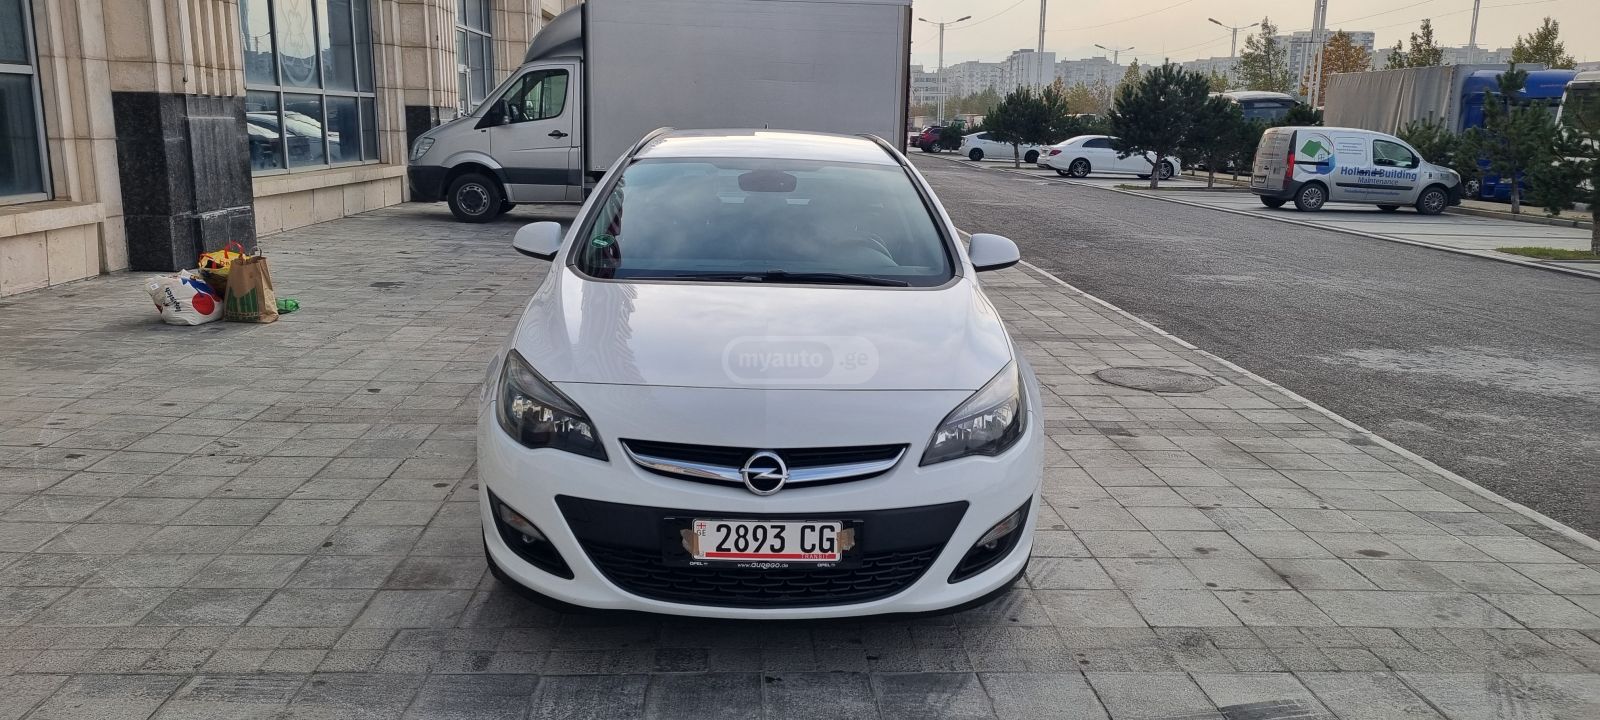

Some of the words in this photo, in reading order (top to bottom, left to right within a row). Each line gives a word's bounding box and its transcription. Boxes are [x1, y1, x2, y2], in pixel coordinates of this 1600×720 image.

[1341, 166, 1377, 177] Holland
[1379, 168, 1417, 182] Building
[1358, 177, 1399, 185] Maintenance
[715, 524, 786, 553] 2893
[800, 524, 836, 553] CG
